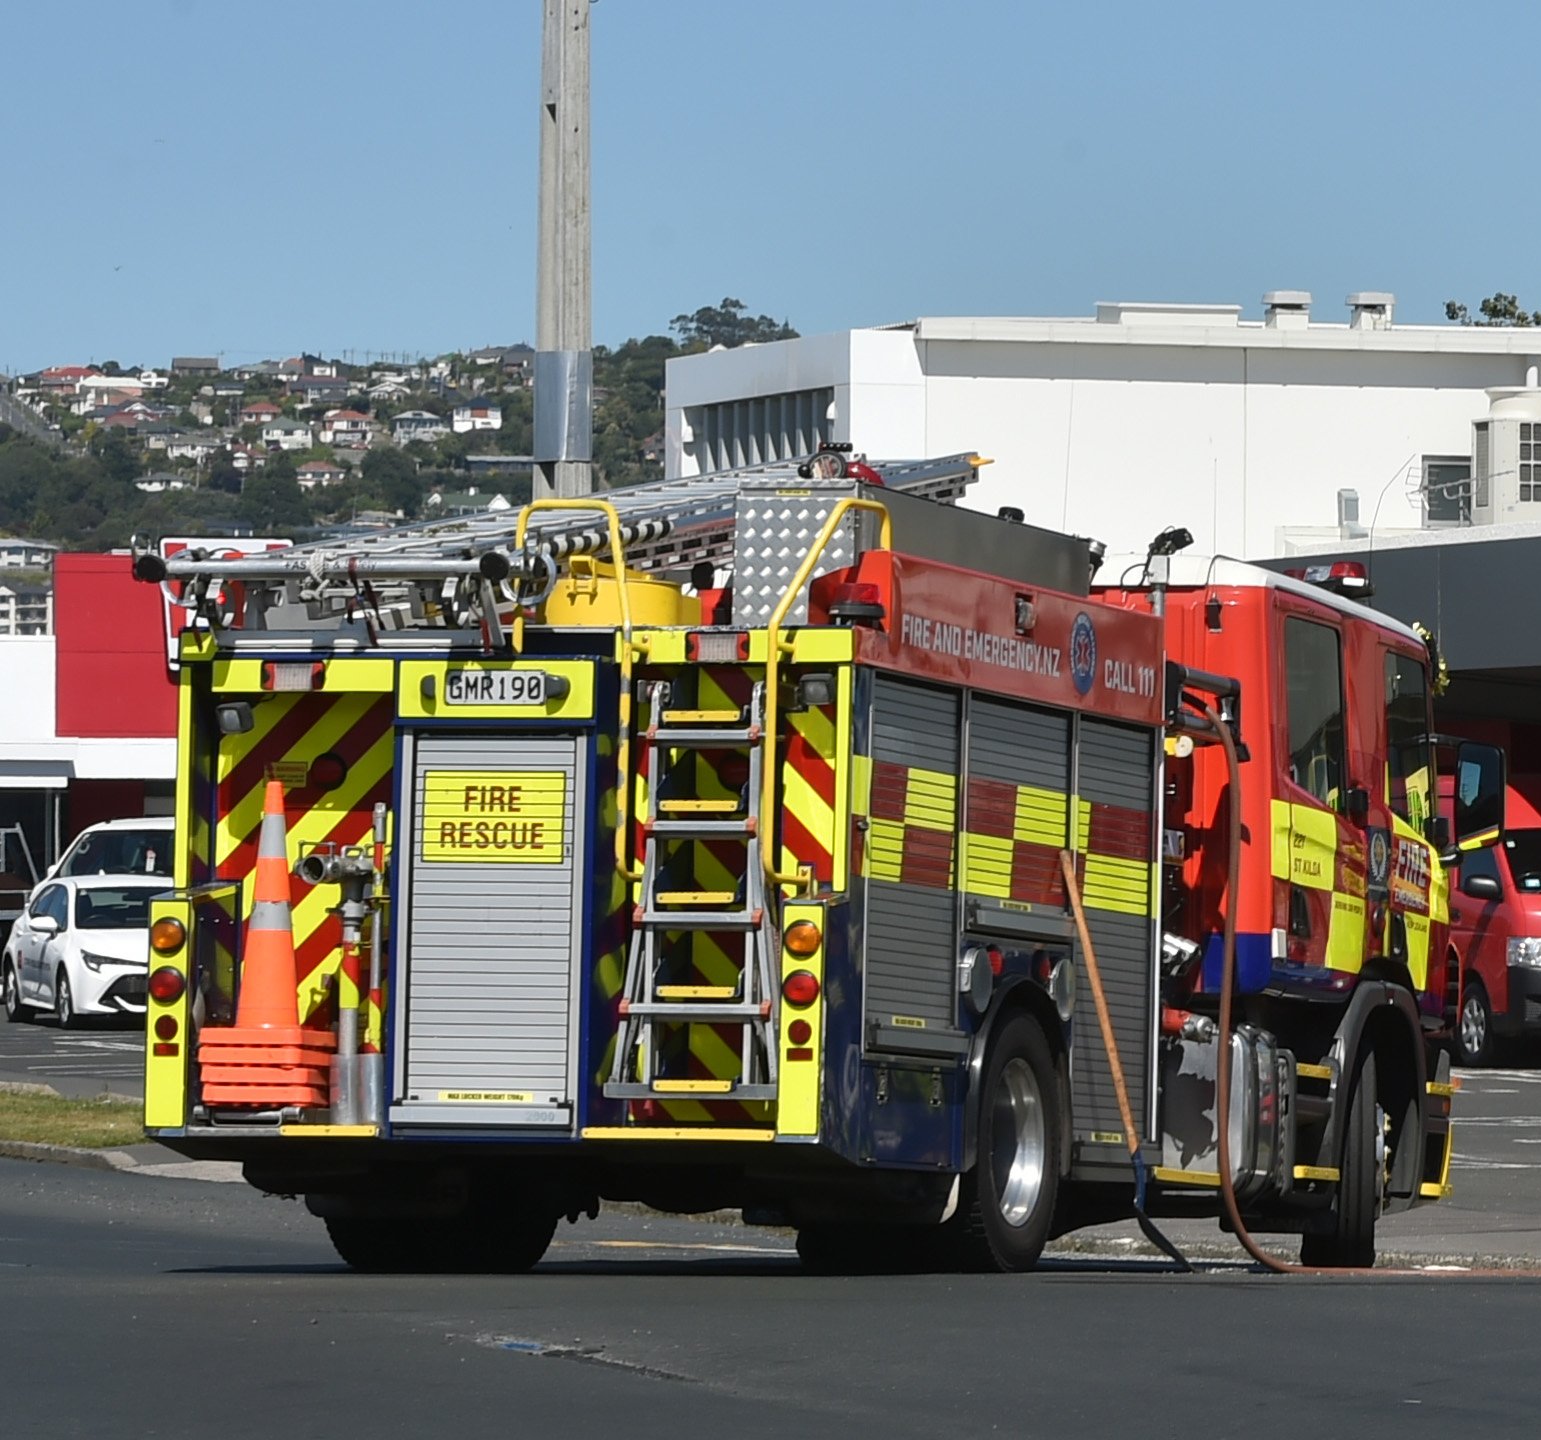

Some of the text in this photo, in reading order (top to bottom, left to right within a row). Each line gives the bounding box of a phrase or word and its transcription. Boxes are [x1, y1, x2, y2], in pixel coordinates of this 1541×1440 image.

[901, 613, 932, 649] FIRE
[933, 621, 961, 657] AND
[964, 628, 1061, 678] EMERGENCY.NZ
[449, 675, 542, 701] GMR190
[1104, 659, 1155, 698] CALL 111
[464, 786, 522, 813] FIRE
[440, 822, 545, 850] RESCUE
